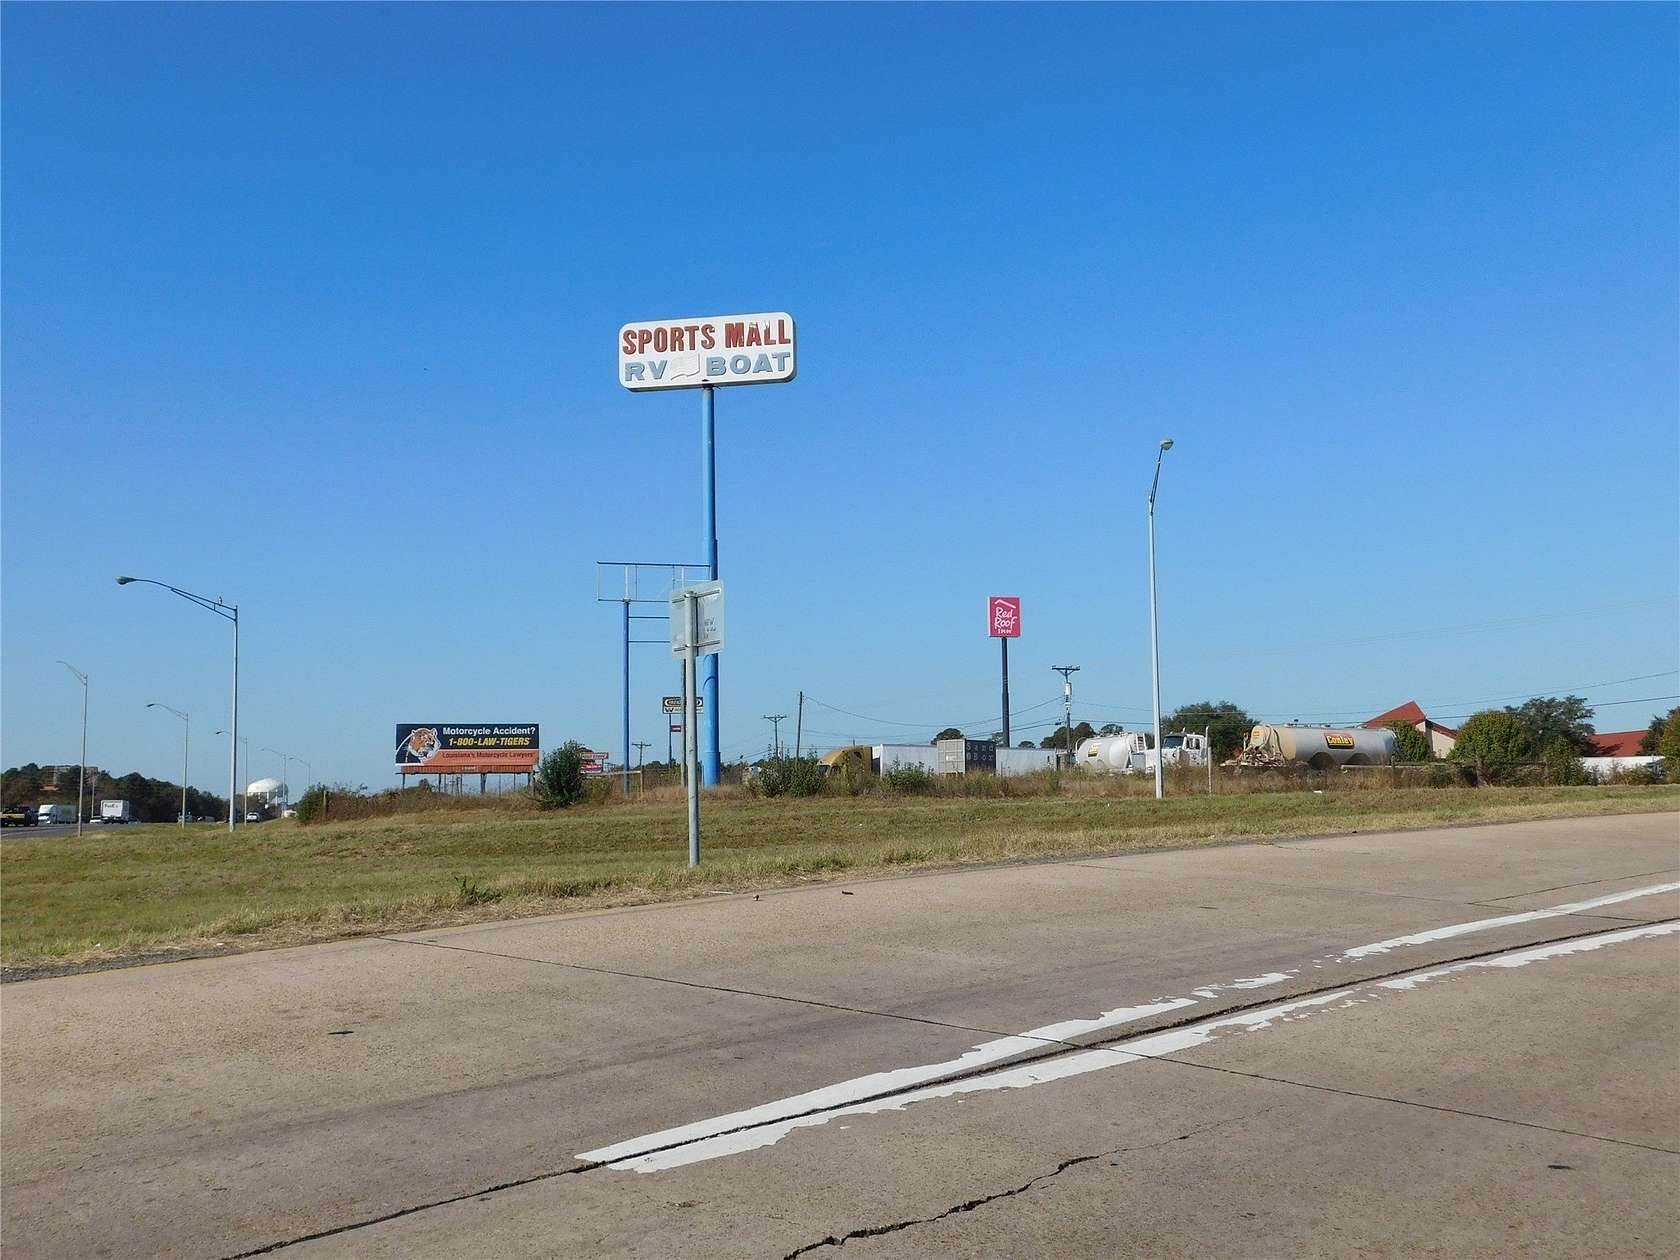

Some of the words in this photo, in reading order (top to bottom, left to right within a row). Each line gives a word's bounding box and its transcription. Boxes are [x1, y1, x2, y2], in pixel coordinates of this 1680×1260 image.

[623, 324, 715, 355] SPORTS
[724, 319, 791, 349] MALL
[624, 360, 667, 382] RV
[706, 352, 791, 377] BOAT
[996, 606, 1013, 618] Red
[994, 616, 1017, 630] Roof
[442, 728, 490, 736] Motorcycle
[493, 727, 536, 735] Accident?
[449, 738, 530, 746] 1-800-LAW-TIGERS
